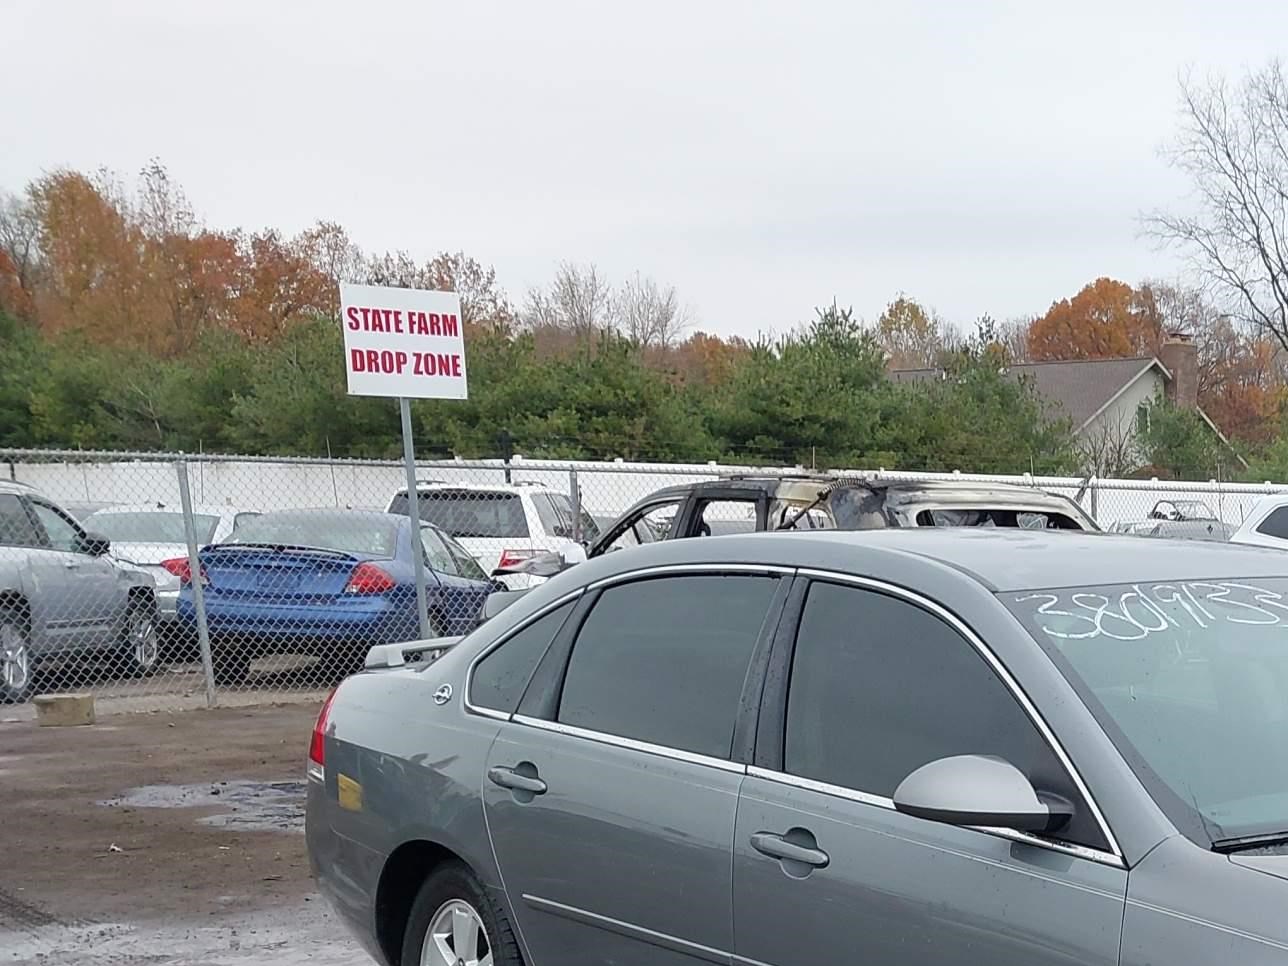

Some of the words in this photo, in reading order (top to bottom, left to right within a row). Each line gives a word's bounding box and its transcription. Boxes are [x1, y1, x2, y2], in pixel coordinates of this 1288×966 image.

[347, 306, 403, 333] STATE
[408, 312, 458, 337] FARM
[351, 349, 407, 374] DROP
[413, 353, 461, 377] ZONE
